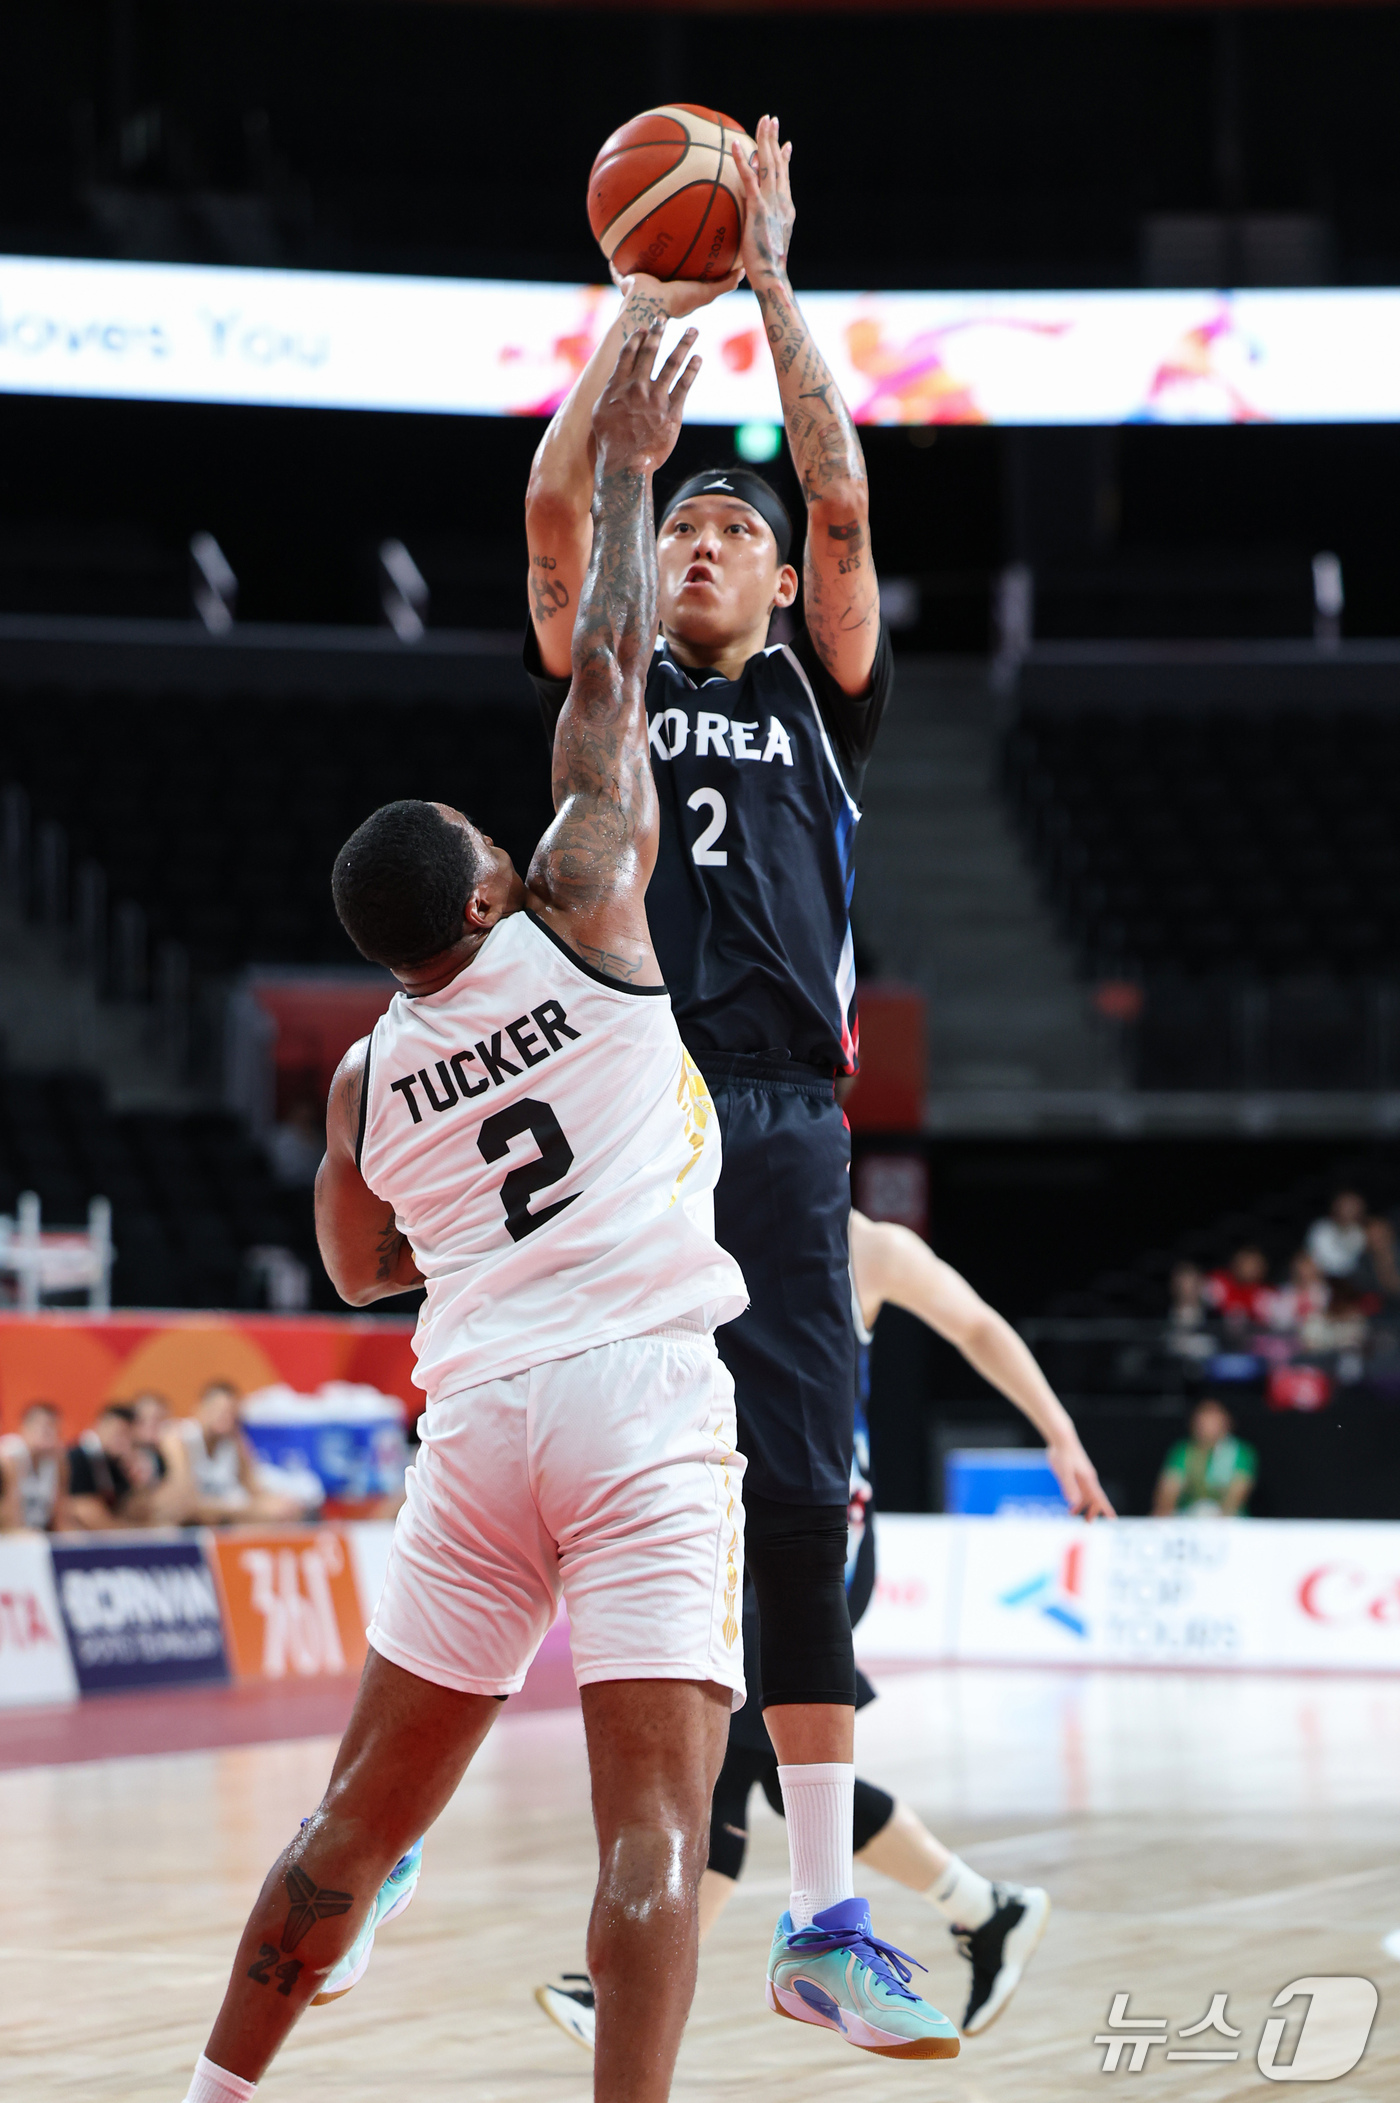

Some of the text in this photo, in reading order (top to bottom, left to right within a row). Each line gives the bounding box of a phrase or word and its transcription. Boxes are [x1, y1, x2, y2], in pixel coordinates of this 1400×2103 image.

[708, 226, 727, 259] 2026
[196, 303, 331, 371] You
[646, 708, 794, 766] KOREA
[687, 787, 728, 866] 2
[390, 999, 582, 1124] TUCKER
[476, 1097, 585, 1243] 2
[247, 1942, 304, 1997] 24
